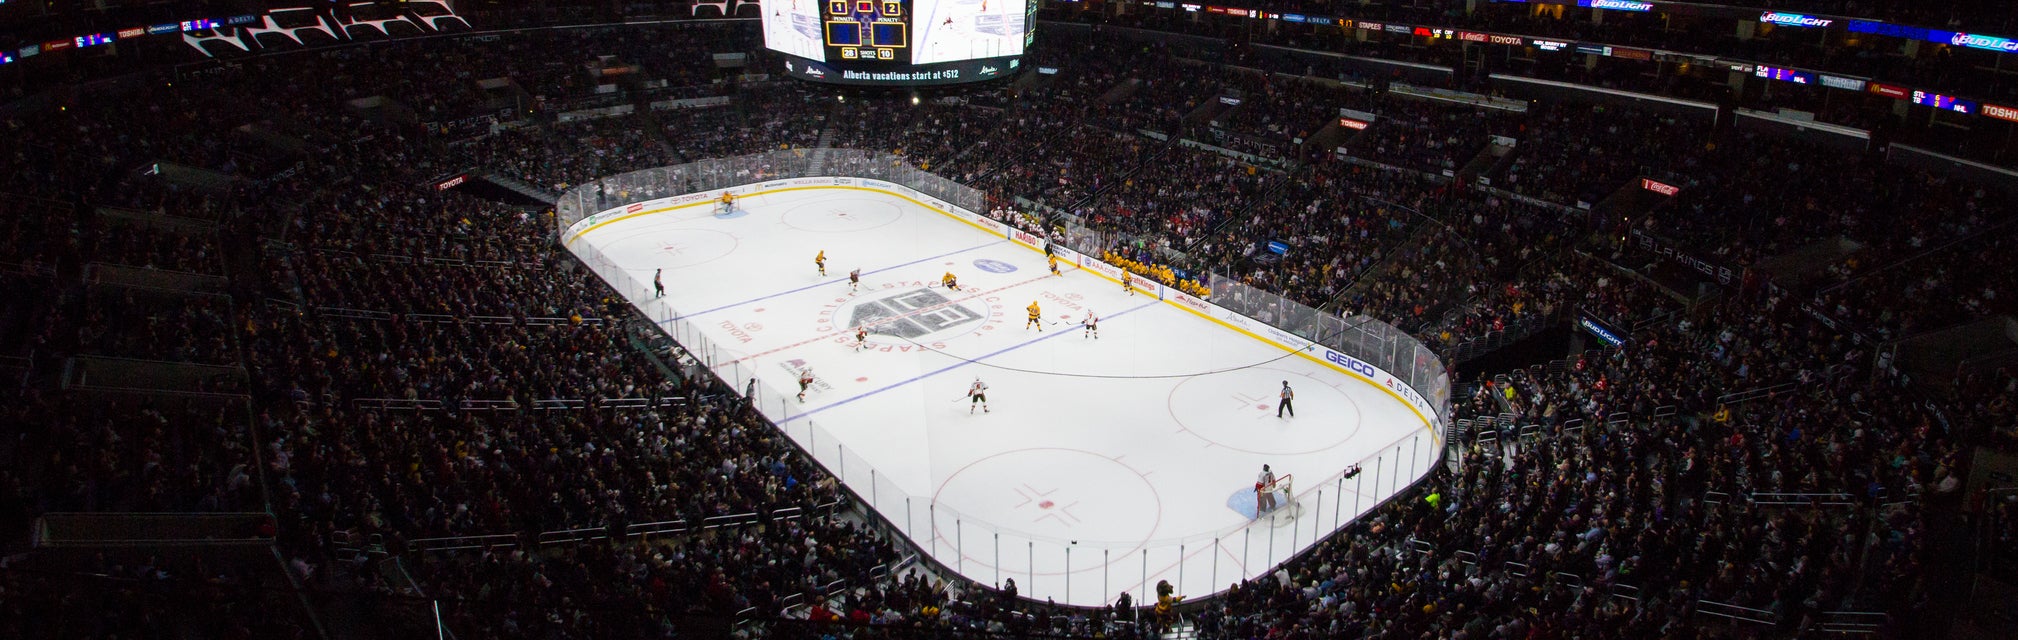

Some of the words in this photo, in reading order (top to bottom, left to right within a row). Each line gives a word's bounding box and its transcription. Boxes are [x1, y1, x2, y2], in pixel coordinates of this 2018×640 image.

[889, 4, 895, 12] 2
[1619, 2, 1654, 11] LIGHT
[1358, 21, 1382, 30] STAPLES
[1766, 13, 1793, 22] BUD
[1793, 15, 1832, 27] LIGHT
[118, 28, 145, 38] TOSHIBA
[1490, 35, 1522, 45] TOYOTA
[1958, 35, 1991, 46] BUD
[1991, 39, 2018, 50] LIG
[881, 50, 890, 58] 10
[843, 70, 870, 80] Alberta
[872, 71, 910, 81] vacations
[912, 71, 931, 81] start
[933, 71, 941, 80] at
[943, 69, 958, 79] $512
[1913, 91, 1926, 99] STL
[1953, 104, 1968, 113] NHL
[1983, 105, 2018, 120] TOSHI
[439, 177, 463, 191] TOYOTA
[682, 193, 708, 202] TOYOTA
[1015, 231, 1036, 246] HARIBO
[1654, 244, 1673, 257] LA
[1676, 251, 1713, 275] KINGS
[1092, 261, 1118, 276] AAA.com
[882, 280, 980, 294] STAPES
[1131, 275, 1155, 291] raftKings
[719, 319, 752, 344] TOYOTA
[1585, 320, 1600, 333] BUD
[1600, 330, 1622, 346] LIGHT
[1325, 350, 1375, 378] GEICO
[1396, 382, 1424, 411] DELTA
